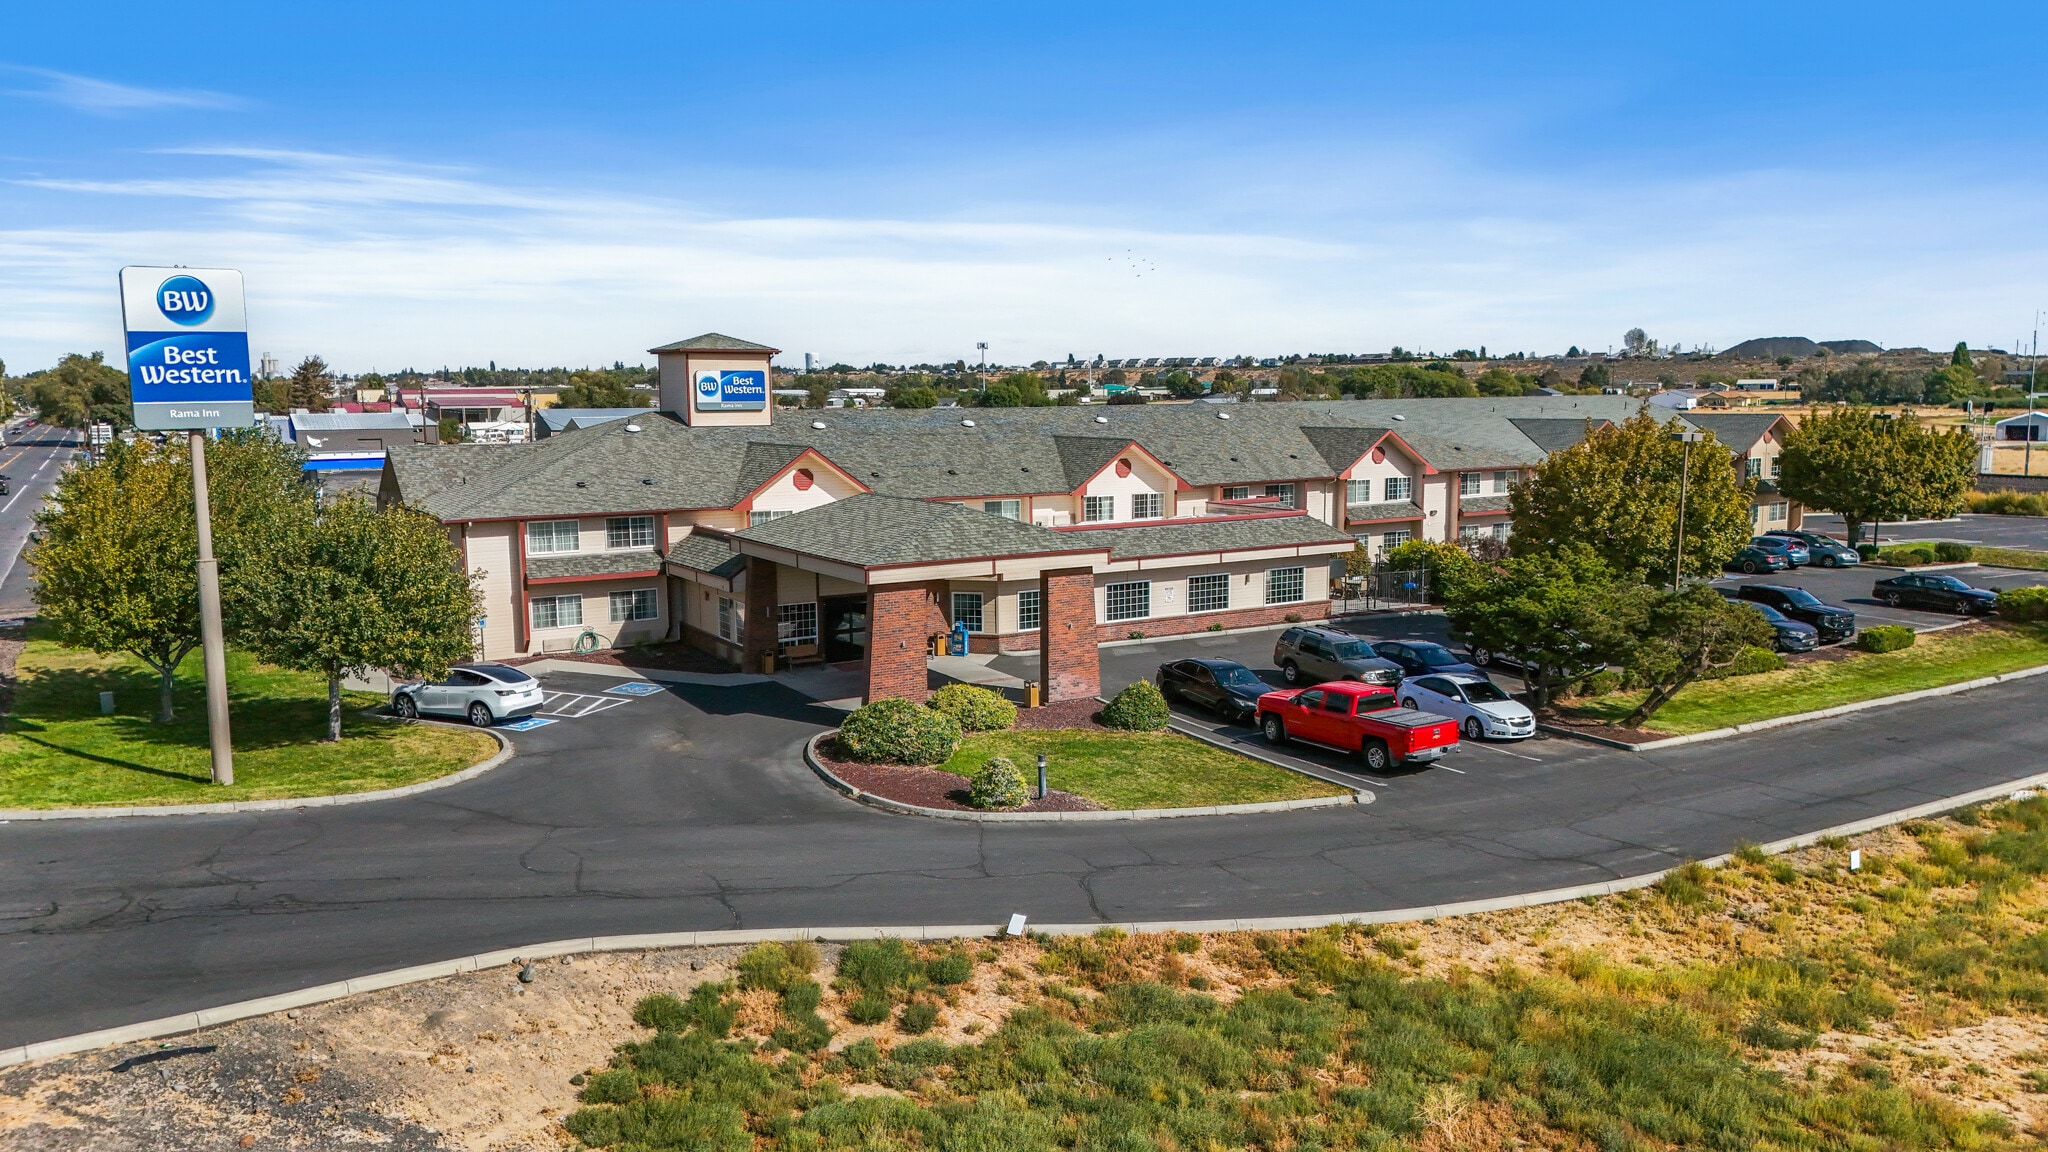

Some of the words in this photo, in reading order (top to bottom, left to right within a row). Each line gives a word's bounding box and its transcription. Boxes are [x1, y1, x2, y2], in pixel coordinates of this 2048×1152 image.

[163, 290, 208, 312] BW
[163, 346, 219, 365] Best
[733, 376, 754, 385] Best
[701, 382, 717, 391] BW
[169, 409, 200, 418] Rama
[202, 409, 220, 418] Inn
